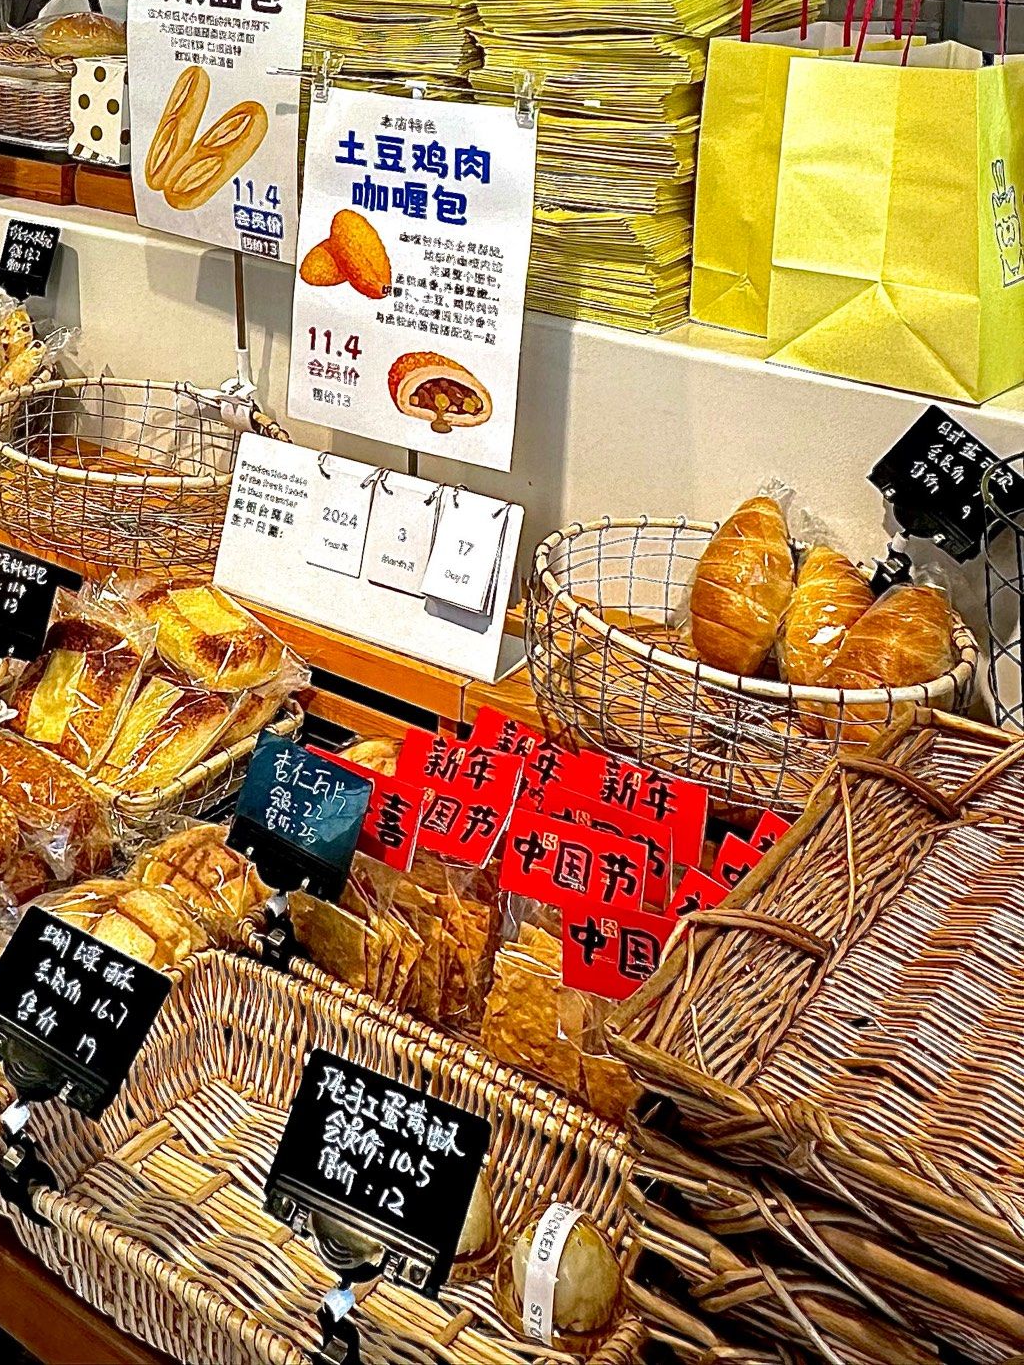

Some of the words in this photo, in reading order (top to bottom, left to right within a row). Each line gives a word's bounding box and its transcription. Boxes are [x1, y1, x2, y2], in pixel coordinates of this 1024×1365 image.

[335, 130, 490, 184] 土豆鸡肉
[233, 177, 281, 209] 11.4
[352, 175, 467, 225] 咖喱包
[235, 209, 281, 235] 会员价
[308, 327, 362, 360] 11.4
[307, 359, 360, 386] 会员价
[927, 444, 965, 485] 会员价
[323, 507, 358, 530] 2024
[398, 527, 407, 543] 3
[458, 539, 474, 556] 17
[425, 737, 496, 789] 新年
[496, 720, 566, 784] 新年
[274, 749, 347, 816] 杏仁瓦片
[599, 756, 680, 821] 新年
[513, 830, 638, 903] 中国节
[570, 916, 661, 981] 中国
[17, 989, 58, 1037] 售价
[35, 957, 82, 1005] 会员价
[91, 997, 128, 1029] 16.7
[318, 1067, 465, 1158] 纯手工蛋黄酥
